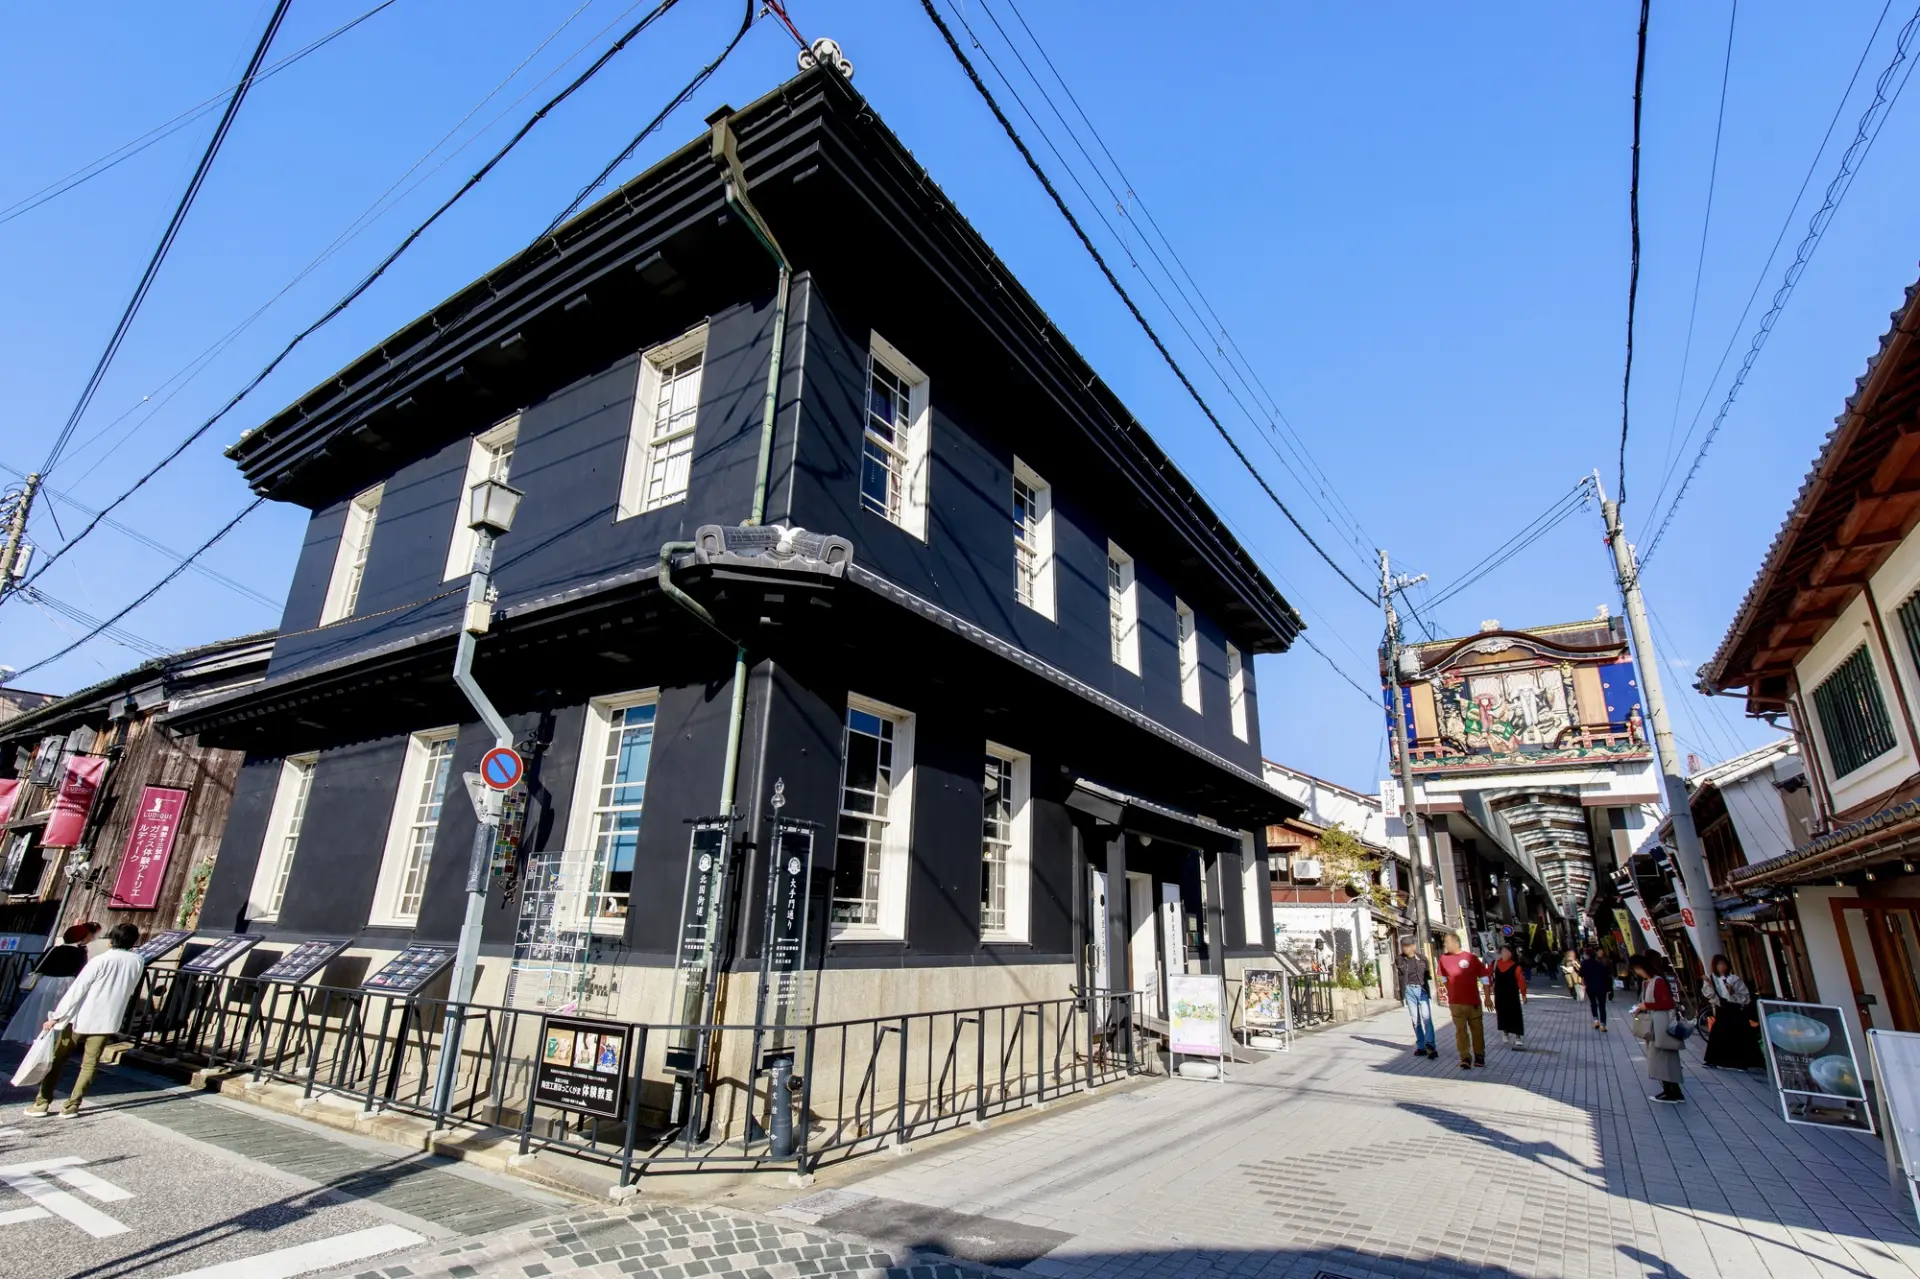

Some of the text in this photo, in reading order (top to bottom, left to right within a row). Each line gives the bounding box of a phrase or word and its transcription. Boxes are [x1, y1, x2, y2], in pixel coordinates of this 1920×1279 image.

[143, 811, 173, 820] LUDIQUE
[130, 824, 149, 862] ルディーク
[130, 825, 160, 897] ガラス体験アトリエ
[787, 878, 797, 931] 大手門通り
[582, 1084, 614, 1102] 体験教室
